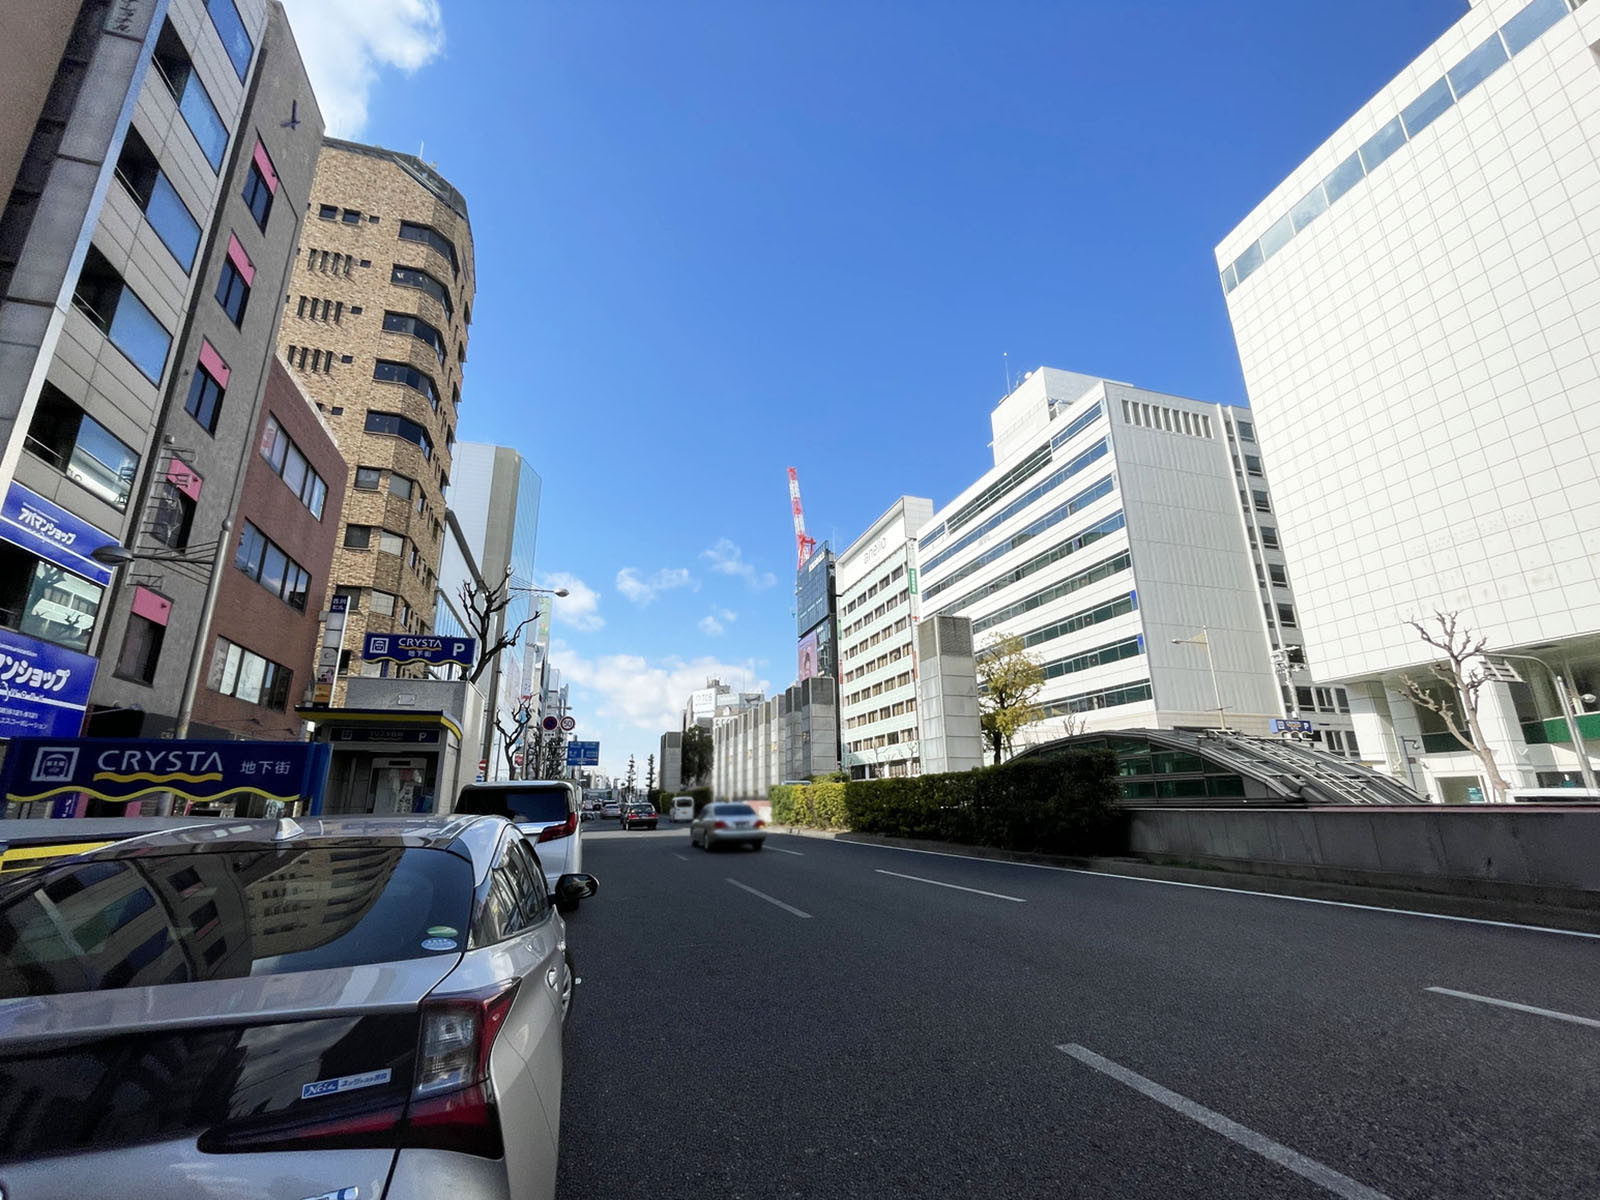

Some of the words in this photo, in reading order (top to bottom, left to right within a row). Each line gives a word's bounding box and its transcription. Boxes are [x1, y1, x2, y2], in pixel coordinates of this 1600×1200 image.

[18, 507, 76, 545] アパマンショップ
[398, 637, 442, 648] CRYSTA
[452, 642, 465, 656] P
[563, 720, 571, 728] 50
[97, 750, 223, 772] CRYSTA
[240, 760, 291, 774] 地下街
